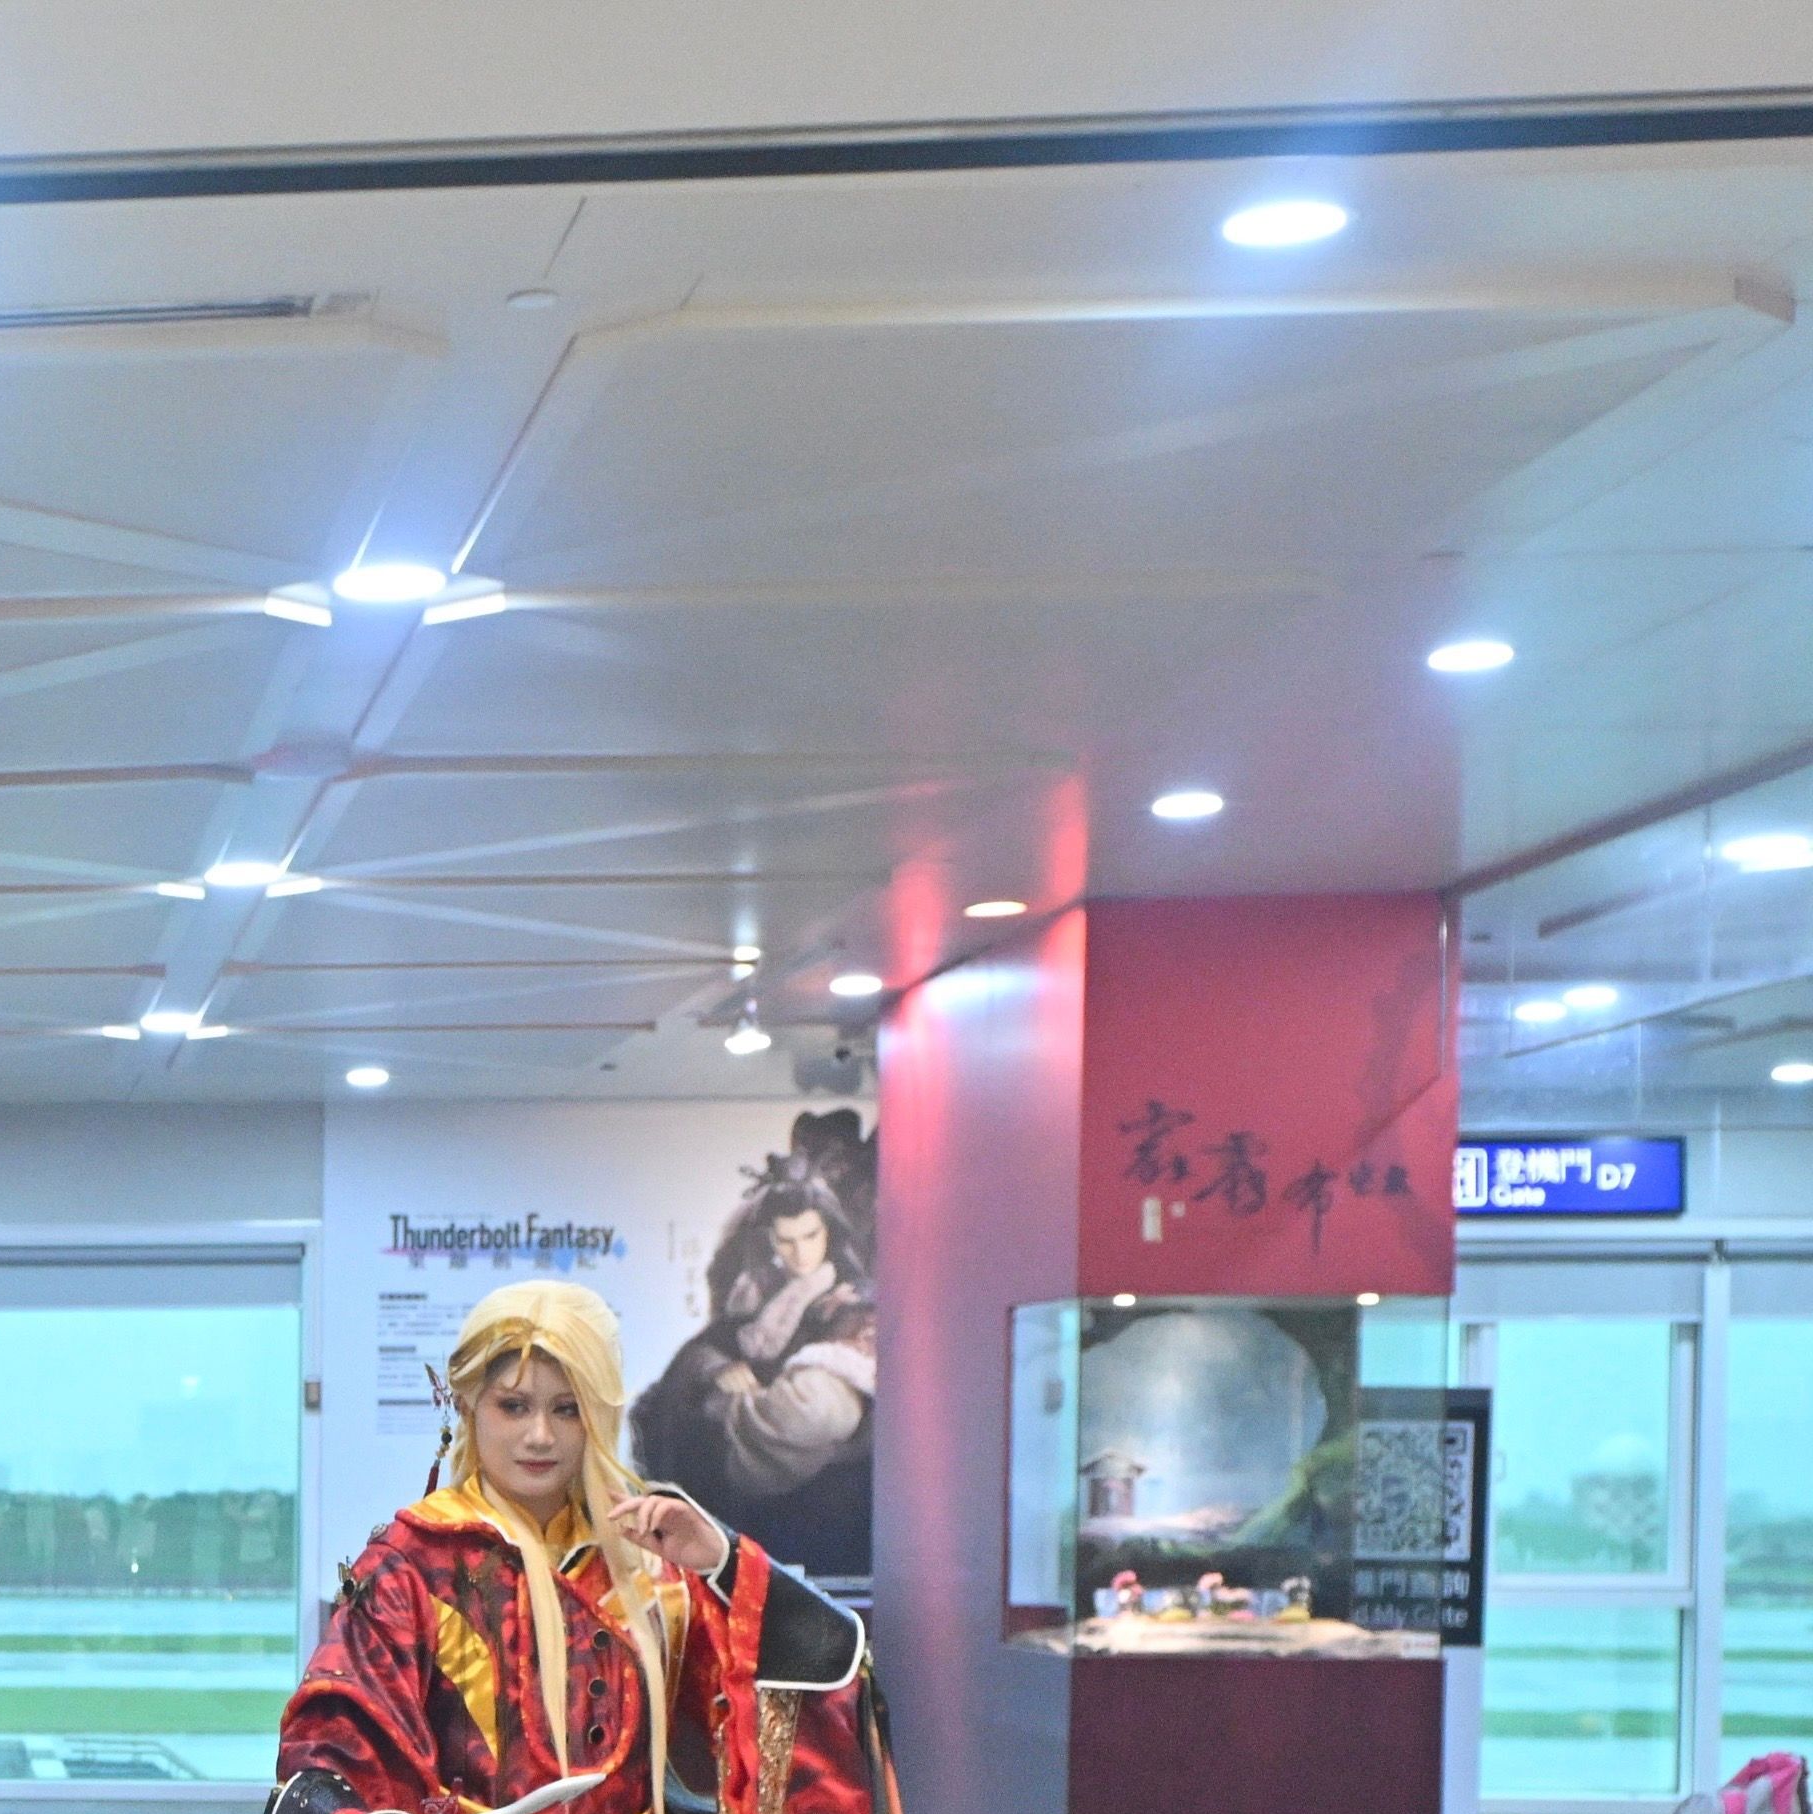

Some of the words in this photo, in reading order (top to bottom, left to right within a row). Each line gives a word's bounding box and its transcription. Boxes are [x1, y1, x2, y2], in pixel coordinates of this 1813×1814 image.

[1596, 1163, 1636, 1191] D7
[390, 1214, 520, 1250] Thunderbolt
[527, 1213, 614, 1255] Fantasy
